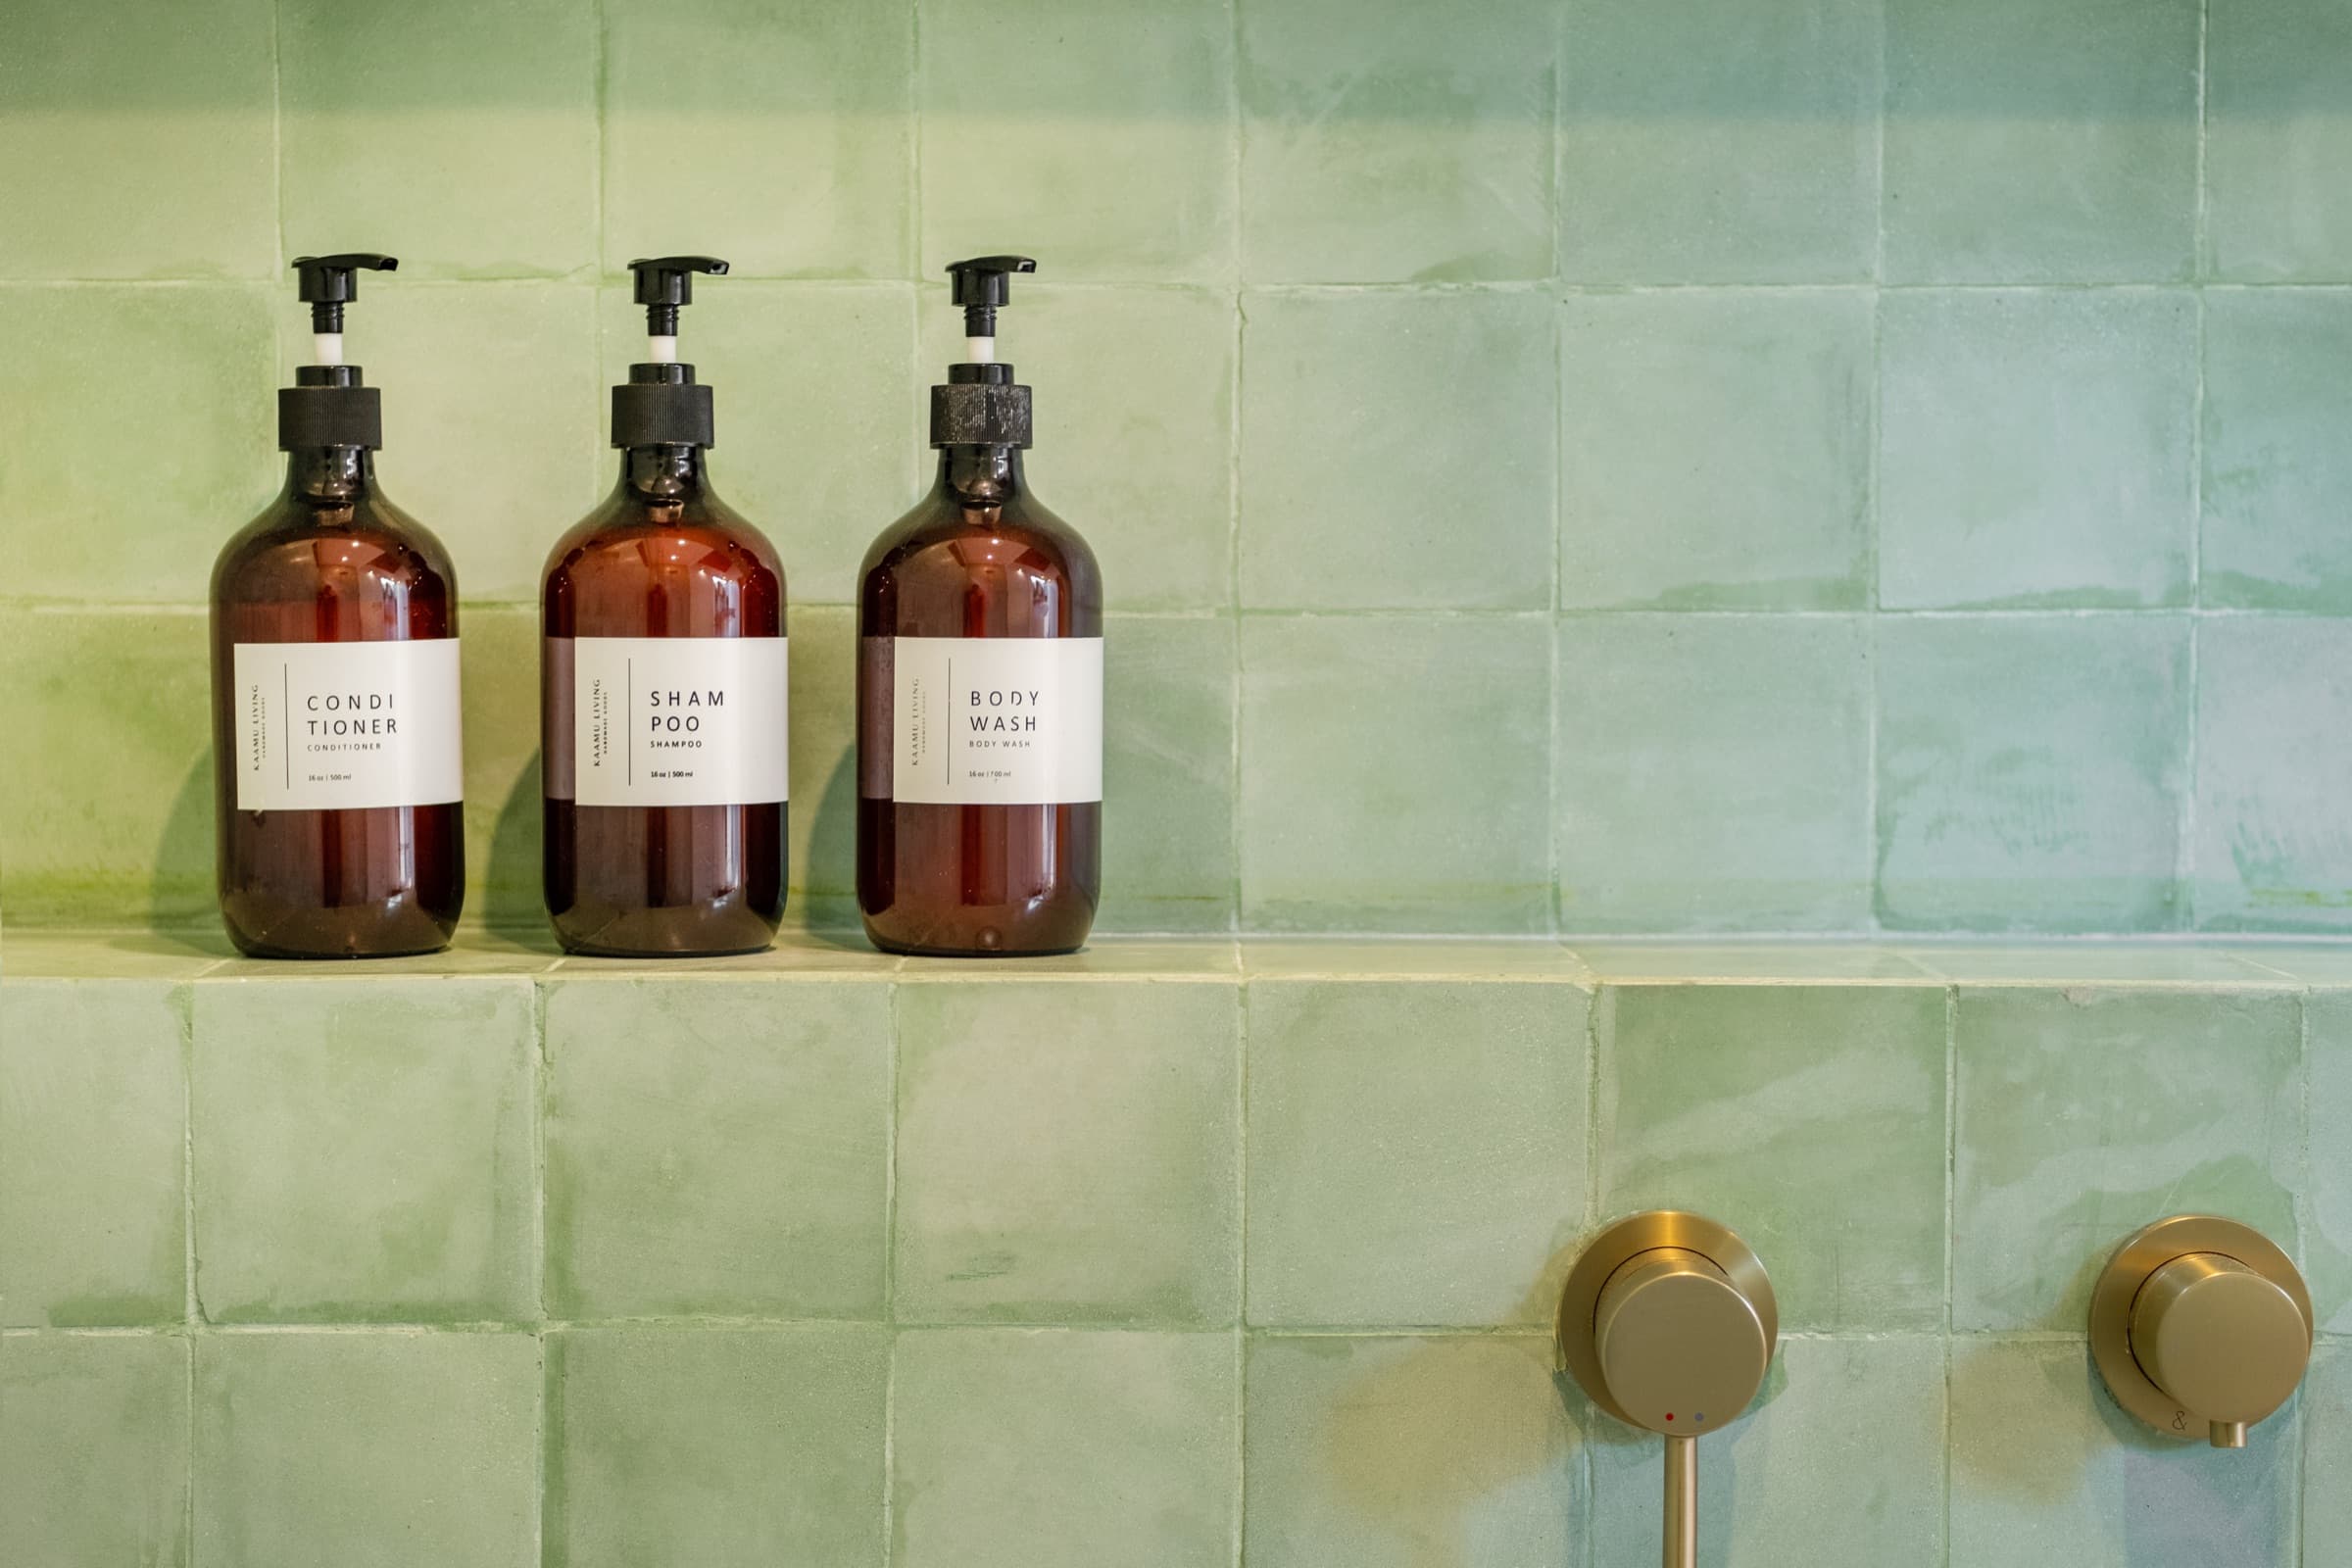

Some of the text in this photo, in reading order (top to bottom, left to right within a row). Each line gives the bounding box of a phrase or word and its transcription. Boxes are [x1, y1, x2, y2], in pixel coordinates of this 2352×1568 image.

[307, 694, 393, 711] CONDI
[650, 691, 724, 707] SHAM
[970, 691, 1039, 707] BODY
[307, 718, 398, 736] TIONER
[651, 715, 700, 732] POO
[970, 715, 1037, 732] WASH
[307, 743, 381, 752] CONDITIONER
[650, 740, 703, 749] SHAMPOO
